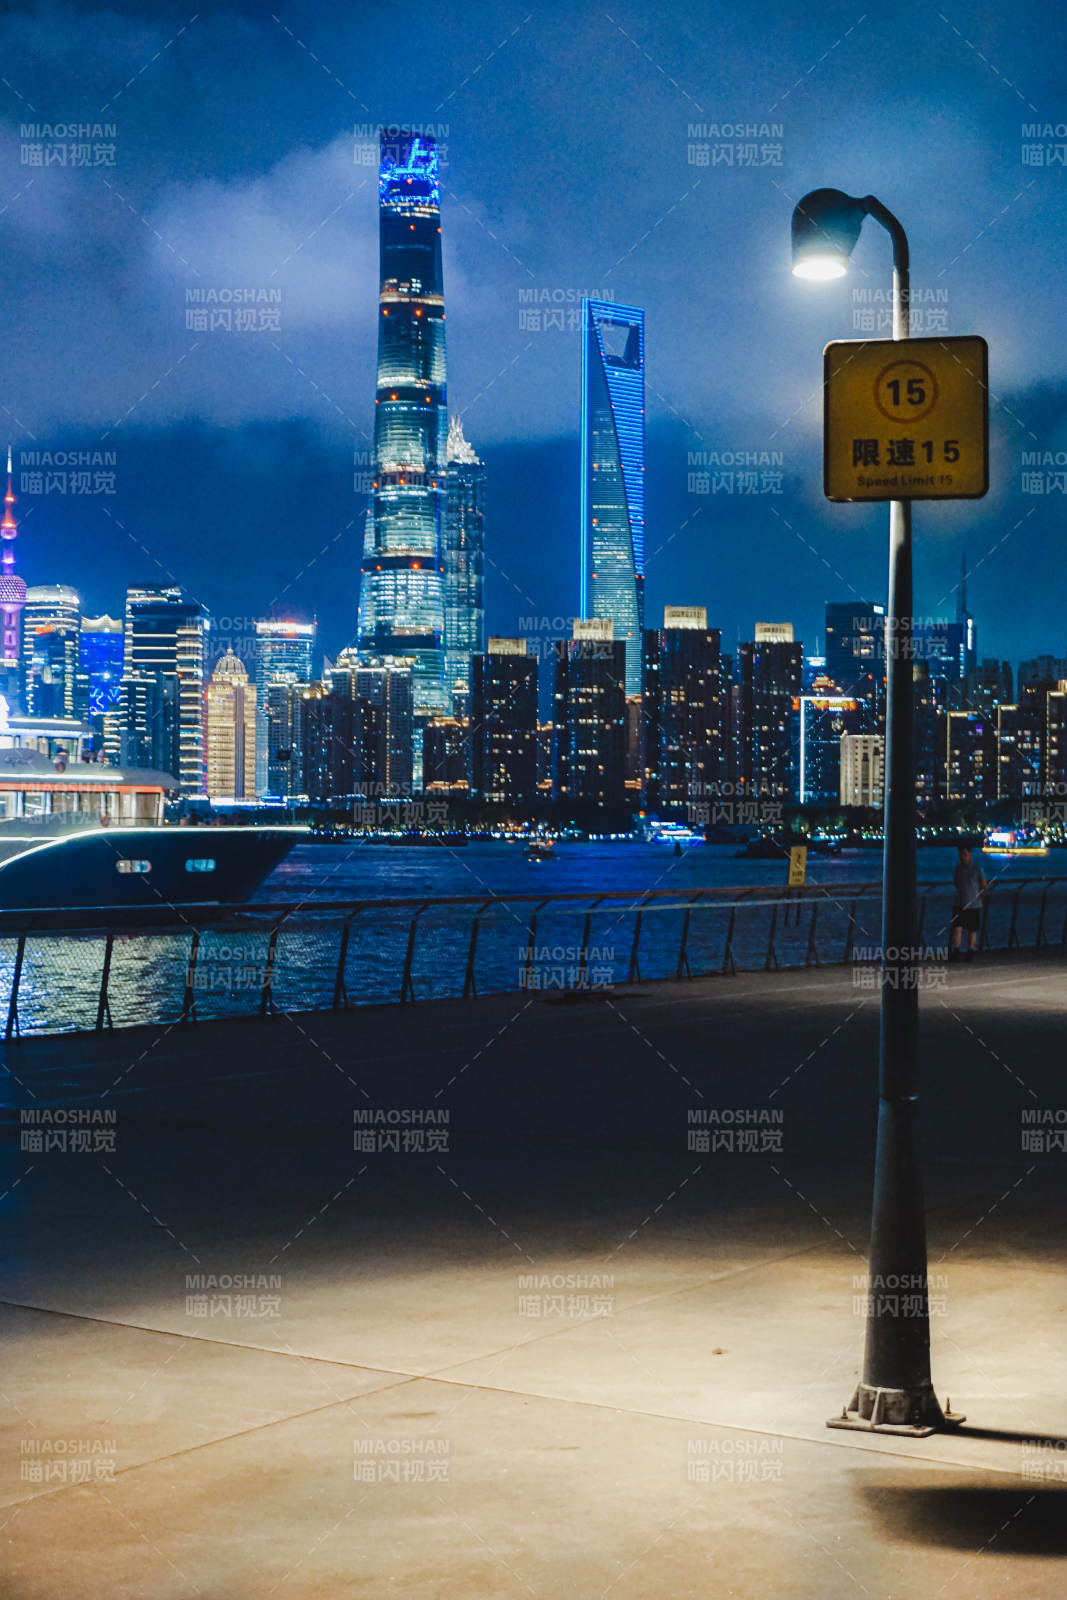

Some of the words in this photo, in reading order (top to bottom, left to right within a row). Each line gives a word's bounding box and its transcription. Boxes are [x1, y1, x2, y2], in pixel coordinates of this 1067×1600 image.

[887, 379, 926, 406] 15
[852, 438, 960, 467] 限速15
[858, 473, 898, 488] Speed
[901, 474, 935, 487] Limit
[940, 474, 953, 486] 15
